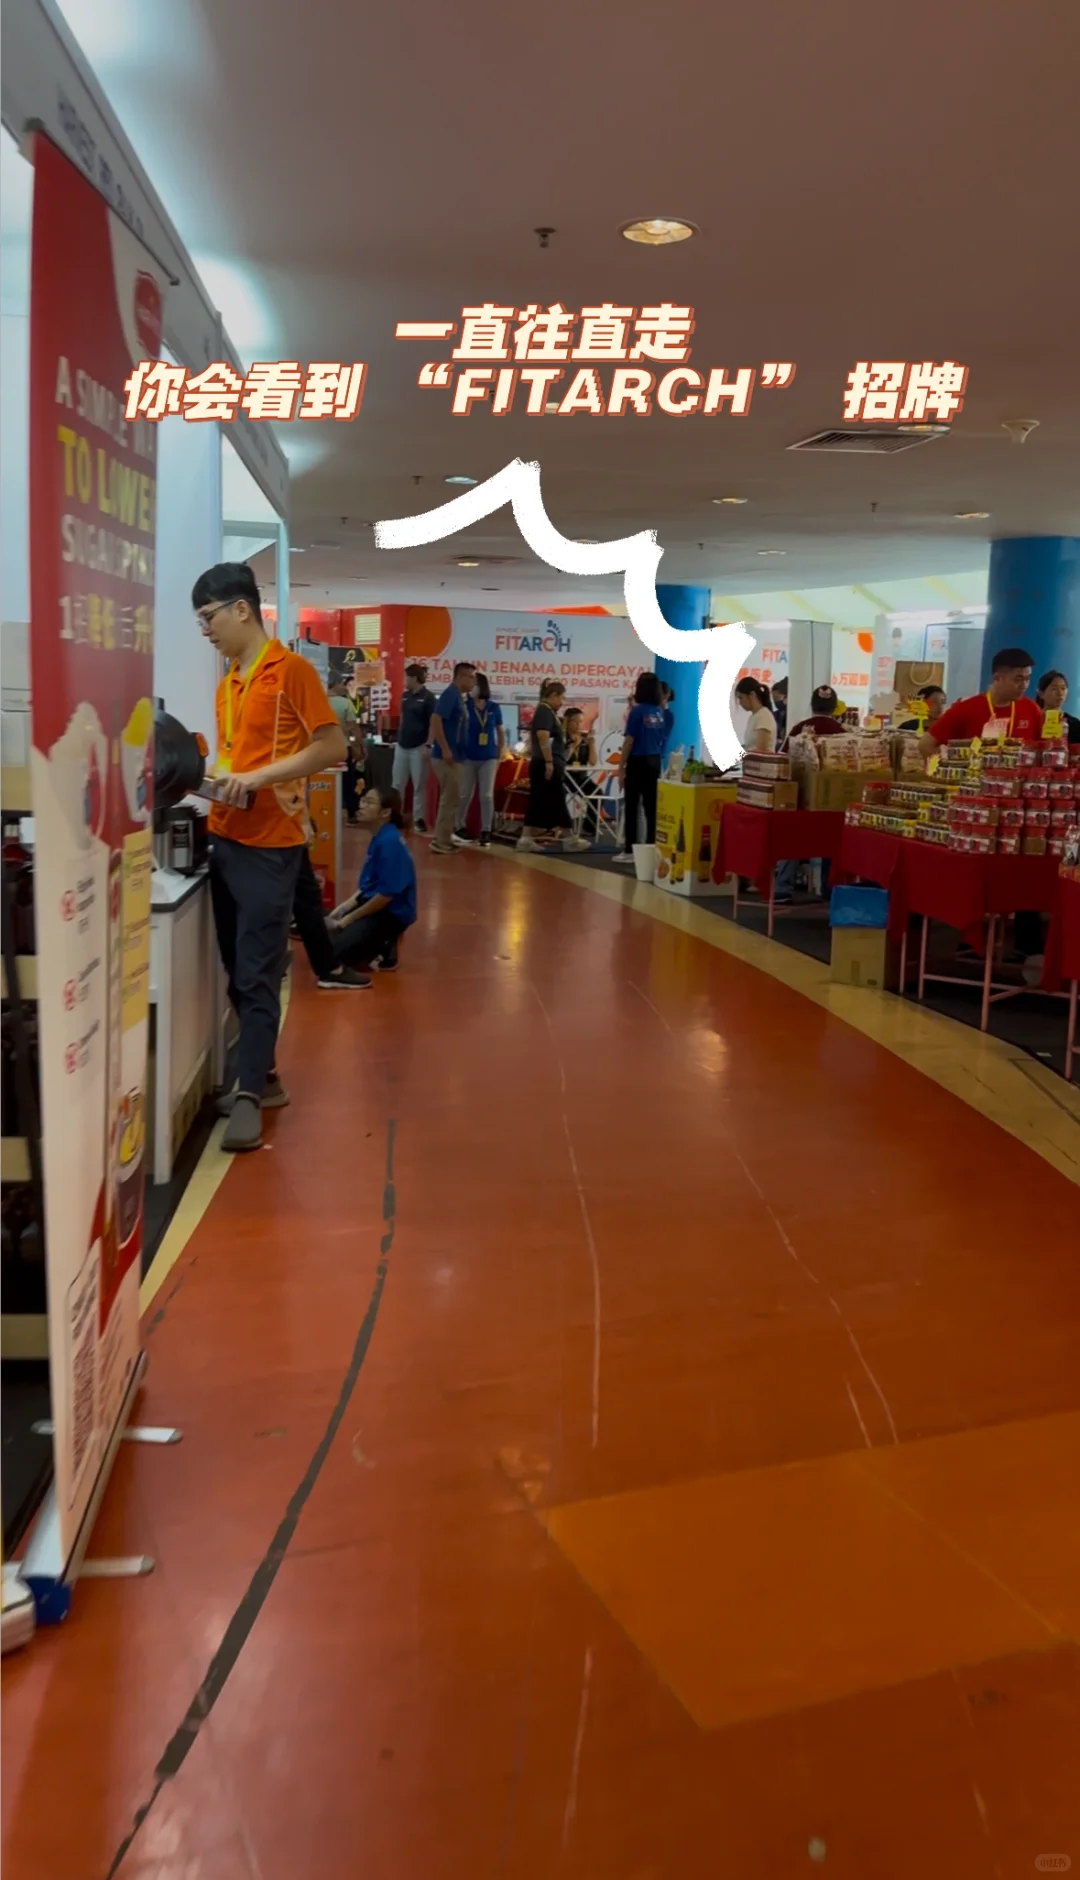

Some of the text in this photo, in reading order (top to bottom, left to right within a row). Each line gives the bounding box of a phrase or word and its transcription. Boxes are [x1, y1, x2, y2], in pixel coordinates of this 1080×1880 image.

[55, 355, 75, 409] A
[57, 423, 92, 504] TO
[495, 635, 571, 653] FITARCH
[491, 661, 556, 675] JENAMA
[490, 675, 524, 686] LEBIH
[571, 678, 619, 689] PASANG
